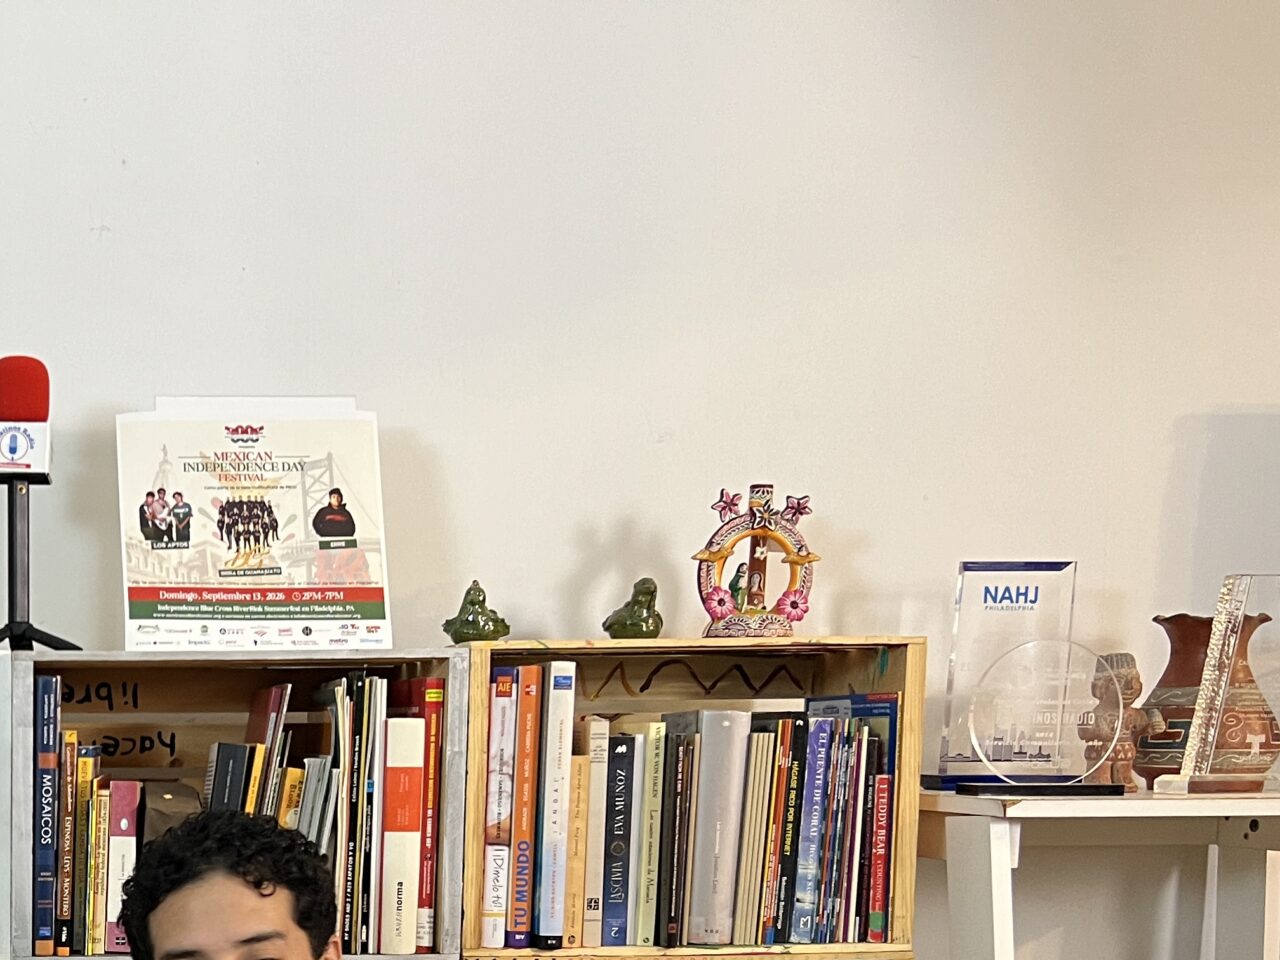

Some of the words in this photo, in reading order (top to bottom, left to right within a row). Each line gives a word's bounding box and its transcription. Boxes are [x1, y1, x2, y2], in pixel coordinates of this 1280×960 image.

[183, 462, 279, 473] INDEPENDENCE
[282, 461, 307, 472] DAY
[213, 451, 273, 462] MEXICAN
[218, 473, 268, 482] FESTIVAL
[159, 590, 201, 602] Domingo,
[202, 591, 252, 603] Septiembre
[266, 591, 286, 601] 2026
[301, 591, 344, 601] 2PM-7PM
[983, 585, 1039, 605] NAHJ
[60, 682, 139, 711] libre
[497, 681, 512, 692] AIE
[78, 731, 176, 758] hace
[818, 732, 827, 746] EL
[789, 760, 800, 789] HÁGASE
[814, 747, 826, 787] PUENTE
[788, 789, 797, 807] RICO
[813, 789, 823, 803] DE
[40, 773, 52, 846] MOSAICOS
[786, 807, 795, 822] POR
[877, 790, 888, 827] TEDDY
[614, 814, 624, 835] EVA
[809, 805, 821, 839] CORAL
[783, 822, 794, 856] INTERNET
[876, 828, 886, 856] BEAR
[515, 840, 530, 903] MUNDO
[608, 861, 624, 903] LASCIVIA
[395, 881, 404, 912] norma
[514, 907, 528, 928] TU
